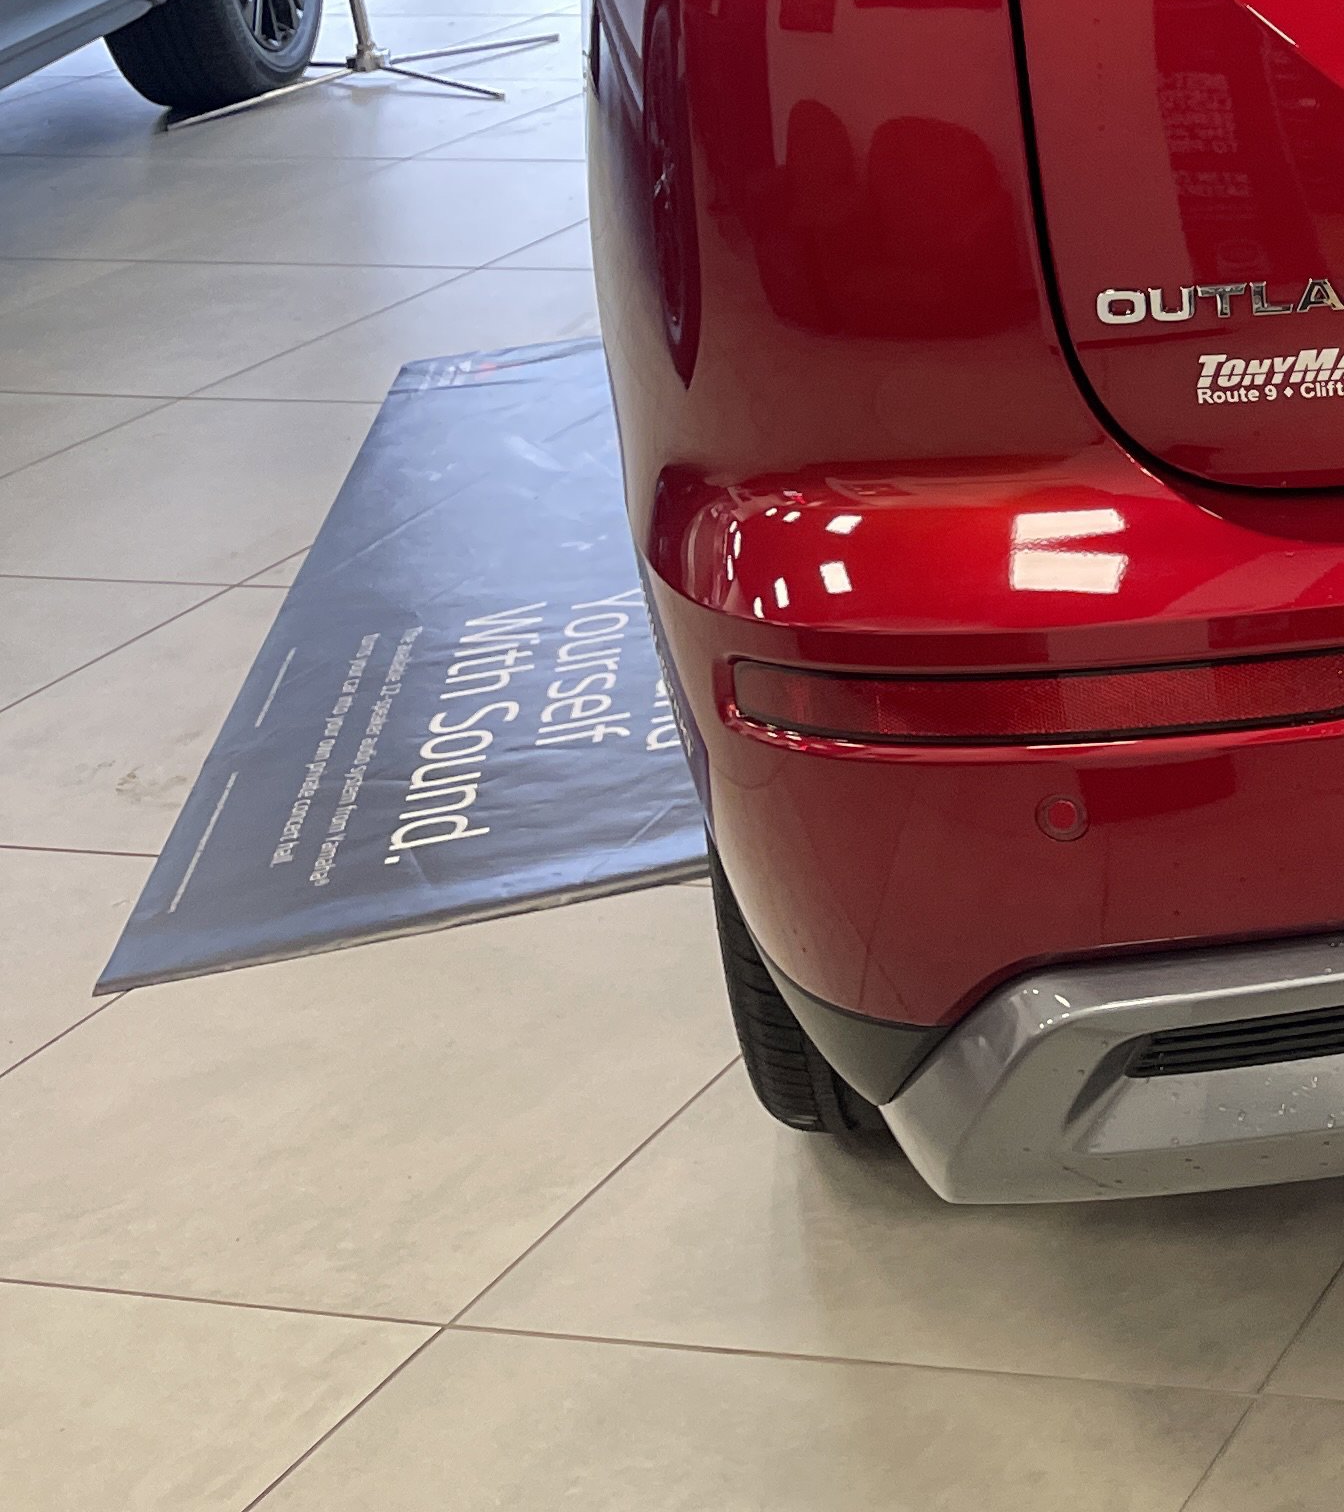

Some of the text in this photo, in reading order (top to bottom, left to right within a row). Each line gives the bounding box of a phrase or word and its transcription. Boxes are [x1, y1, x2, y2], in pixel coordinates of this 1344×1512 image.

[1198, 388, 1260, 404] Route
[1266, 385, 1278, 401] 9
[384, 601, 547, 865] With Sound.
[535, 587, 647, 746] Yourself
